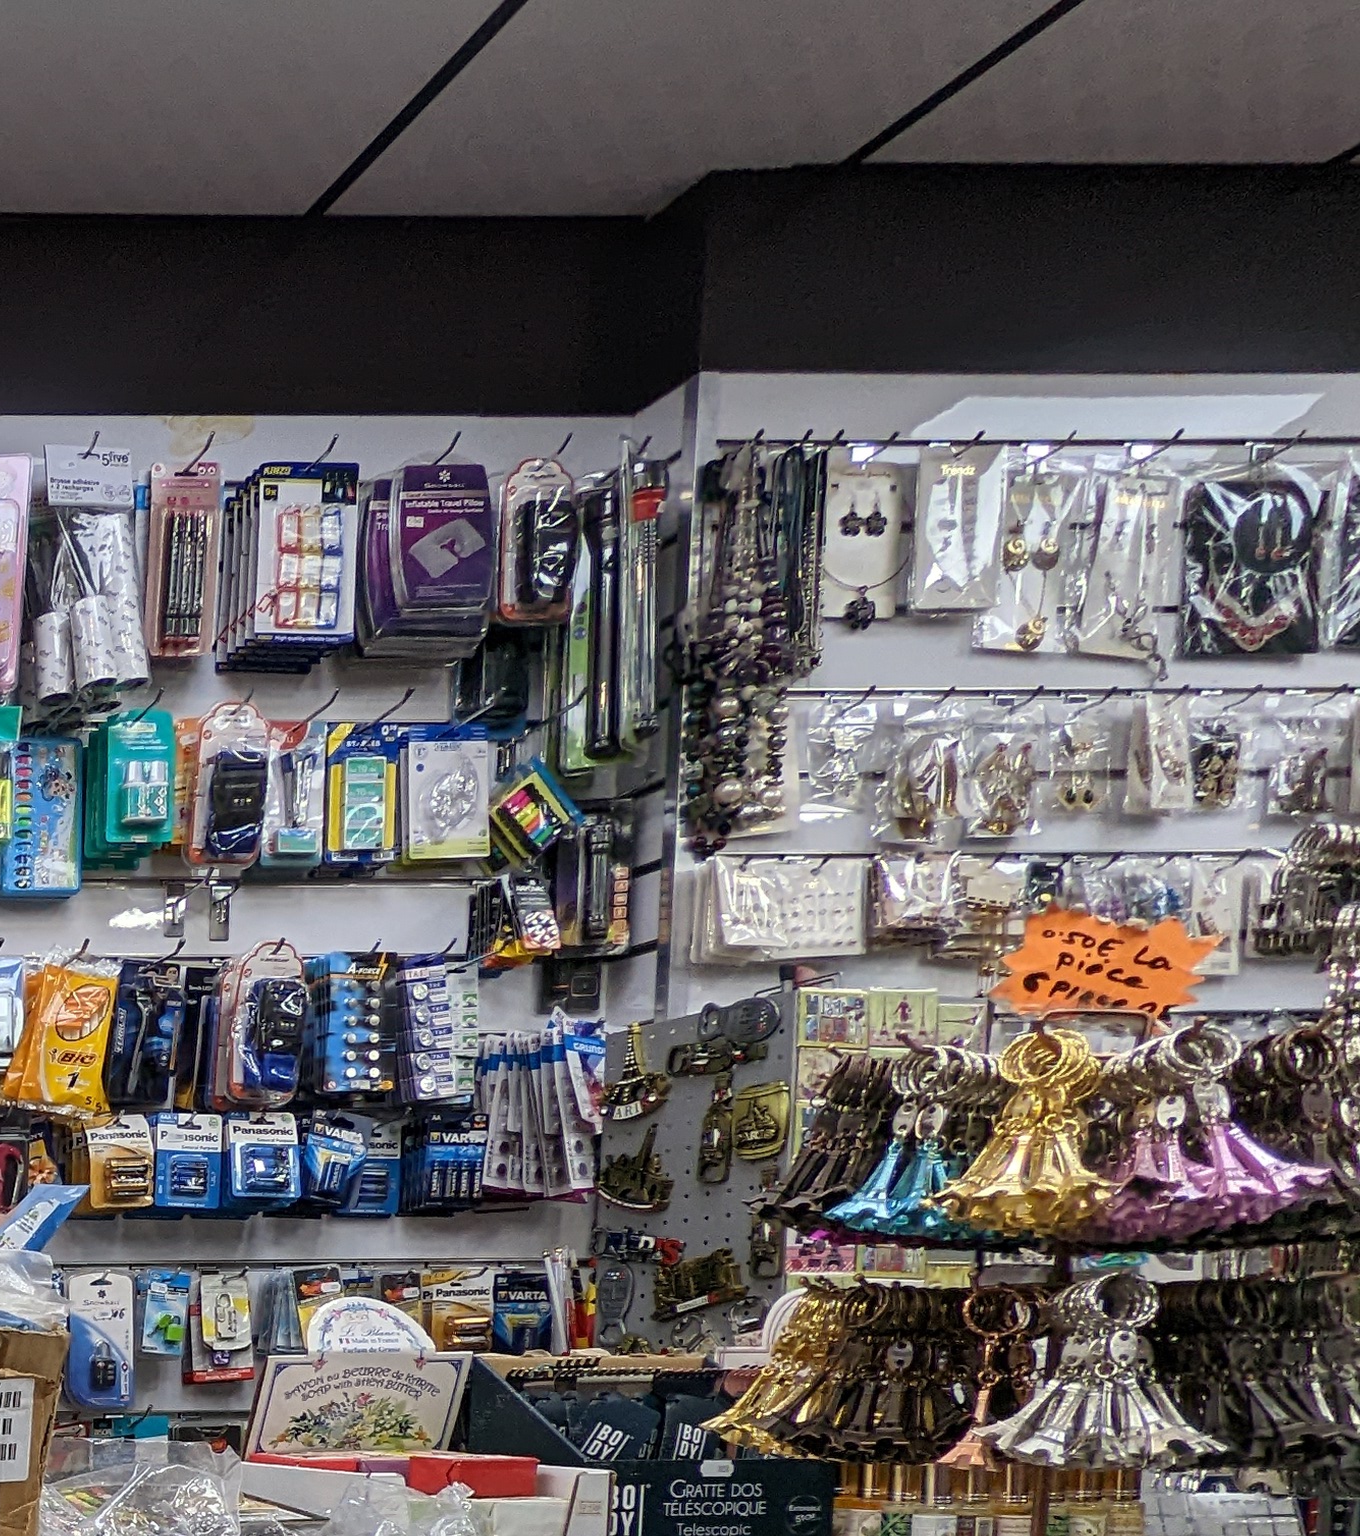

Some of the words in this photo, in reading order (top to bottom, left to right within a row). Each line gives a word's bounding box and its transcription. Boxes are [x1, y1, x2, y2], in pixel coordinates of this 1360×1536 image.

[405, 498, 440, 509] Inflatable
[440, 498, 461, 508] Travel
[463, 498, 485, 508] Pillow
[60, 1052, 97, 1065] BIC
[89, 1128, 149, 1141] Panasonic
[232, 1125, 291, 1136] Panasonic
[436, 1286, 491, 1298] Panasonic
[508, 1290, 548, 1302] VARTA
[301, 1384, 332, 1402] SOAP
[333, 1379, 353, 1391] with
[669, 1479, 726, 1499] GRATTE
[730, 1483, 764, 1498] DOS
[676, 1522, 753, 1536] Telescopic
